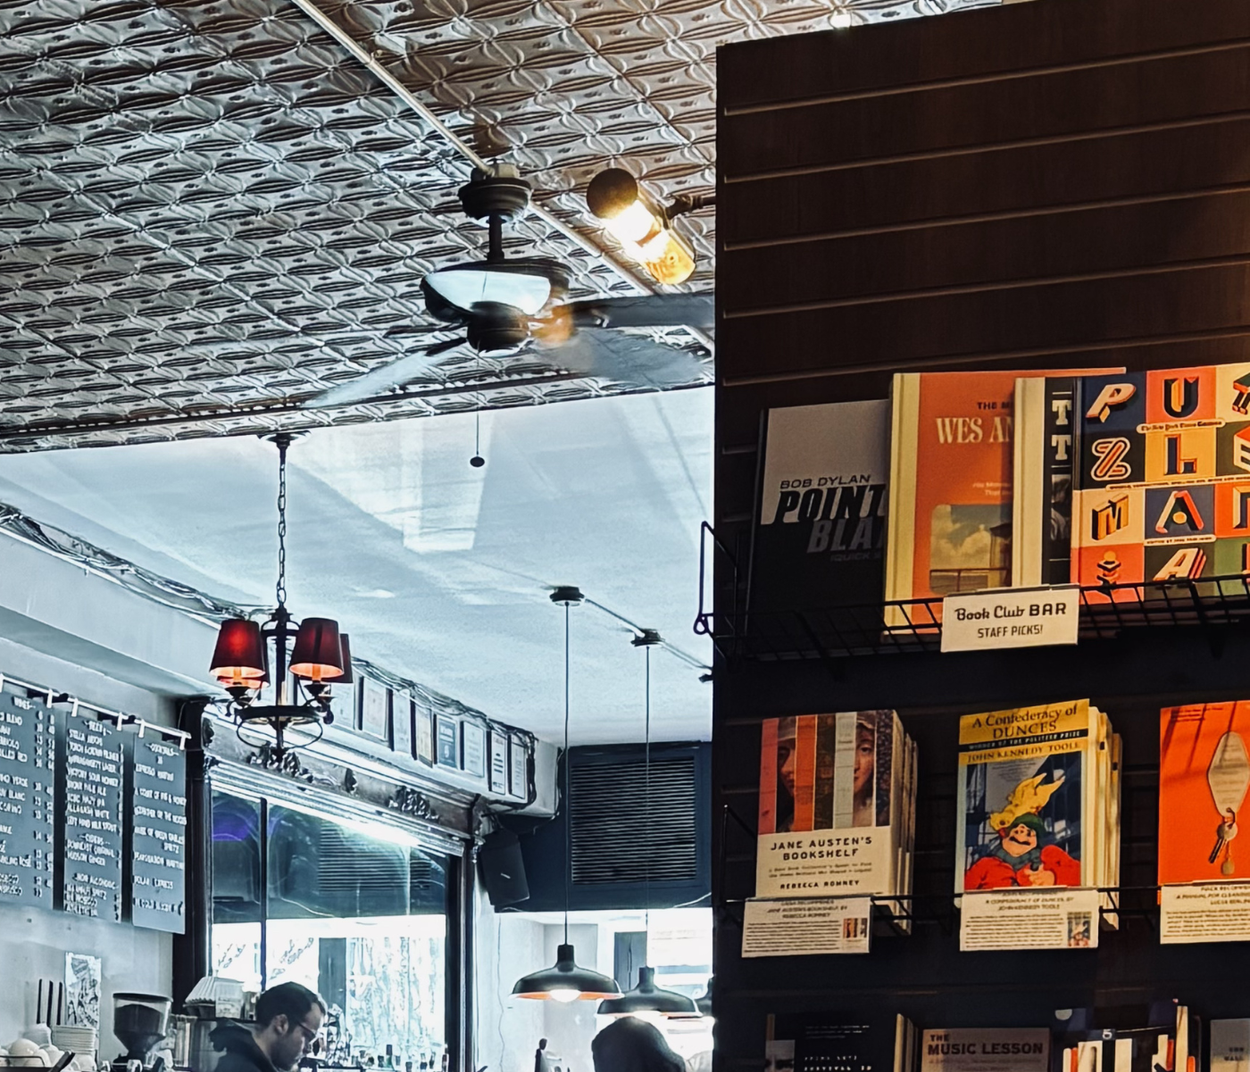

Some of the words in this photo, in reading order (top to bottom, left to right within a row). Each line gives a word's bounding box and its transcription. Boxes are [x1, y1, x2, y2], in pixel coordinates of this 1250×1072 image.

[976, 401, 998, 410] THE
[935, 417, 983, 444] WES
[779, 478, 812, 490] BOB
[817, 474, 871, 488] DYLAN
[955, 607, 990, 621] Book
[993, 605, 1025, 619] Club
[1029, 602, 1067, 617] BAR
[977, 626, 1008, 638] STAFF
[1011, 624, 1043, 636] PICKS!
[972, 718, 982, 728] A
[985, 707, 1062, 727] Confederacy
[1065, 703, 1078, 716] of
[992, 720, 1057, 740] DUNCES
[967, 751, 995, 763] JOHN
[996, 746, 1043, 758] KENNEDY
[1048, 741, 1078, 752] TOOLE
[770, 840, 803, 851] JANE
[809, 836, 872, 848] AUSTEN'S
[783, 848, 859, 861] BOOKSHELF
[780, 882, 819, 890] REBECCA
[824, 880, 860, 888] ROMNEY
[930, 1033, 950, 1042] THE
[927, 1043, 976, 1055] MUSIC
[982, 1042, 1043, 1054] LESSON
